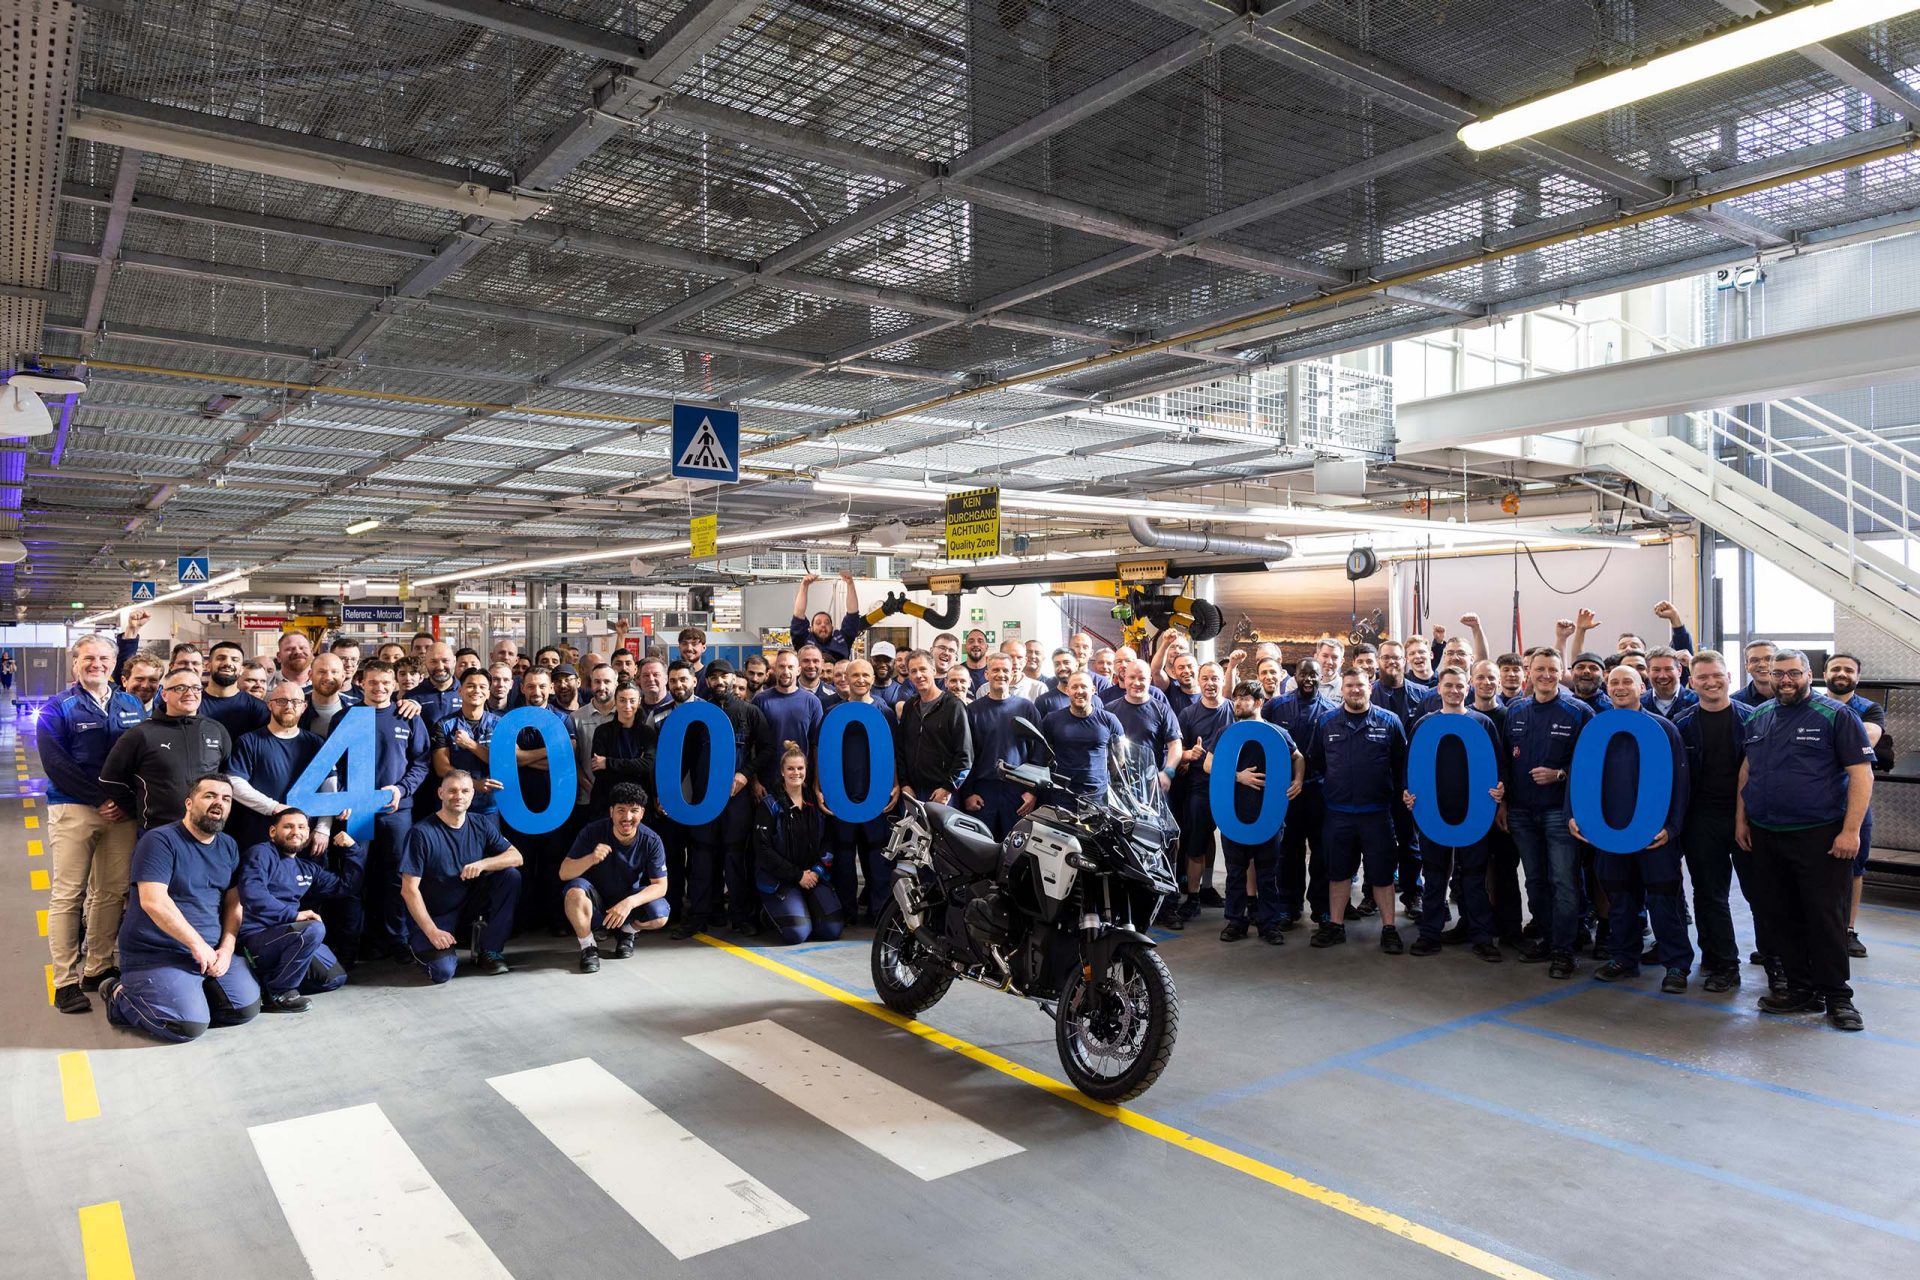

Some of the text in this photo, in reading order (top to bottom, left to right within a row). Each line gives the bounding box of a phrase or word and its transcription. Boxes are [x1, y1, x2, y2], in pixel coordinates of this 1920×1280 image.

[963, 497, 981, 508] KEIN
[949, 508, 996, 523] DURCHGANG
[952, 523, 989, 536] ACHTUNG
[950, 538, 995, 551] Quality Zone
[345, 609, 372, 619] Referenz
[376, 609, 403, 619] Motorrad
[286, 701, 1675, 855] 4 0 0 0 0 0 0
